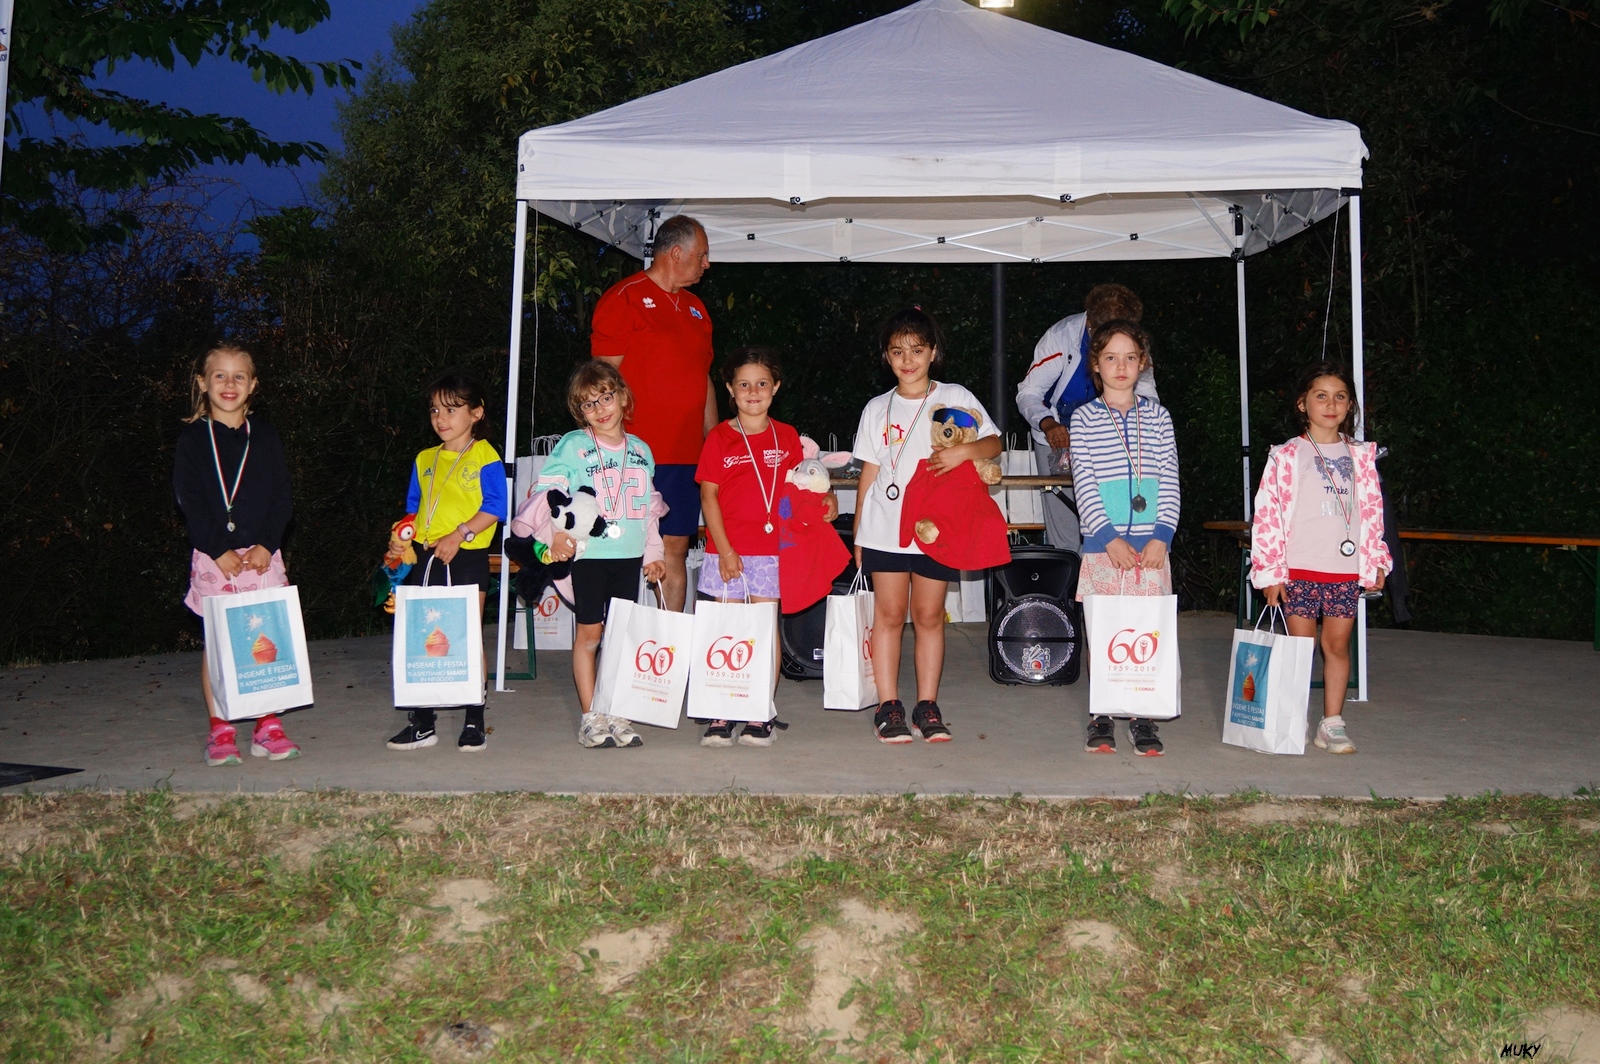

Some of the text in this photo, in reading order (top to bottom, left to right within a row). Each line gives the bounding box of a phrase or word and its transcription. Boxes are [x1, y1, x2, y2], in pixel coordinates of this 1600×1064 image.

[587, 451, 605, 464] VIBS
[593, 468, 647, 520] 82
[533, 596, 559, 617] 0
[706, 636, 753, 671] 60
[1107, 629, 1158, 664] 60
[407, 661, 436, 669] INSIEME
[635, 640, 674, 676] 60
[238, 669, 266, 679] INSIEME
[274, 664, 296, 674] FESTA!
[278, 673, 297, 681] SABATO
[634, 672, 672, 685] 1959-2019
[706, 671, 751, 679] 1959-2019
